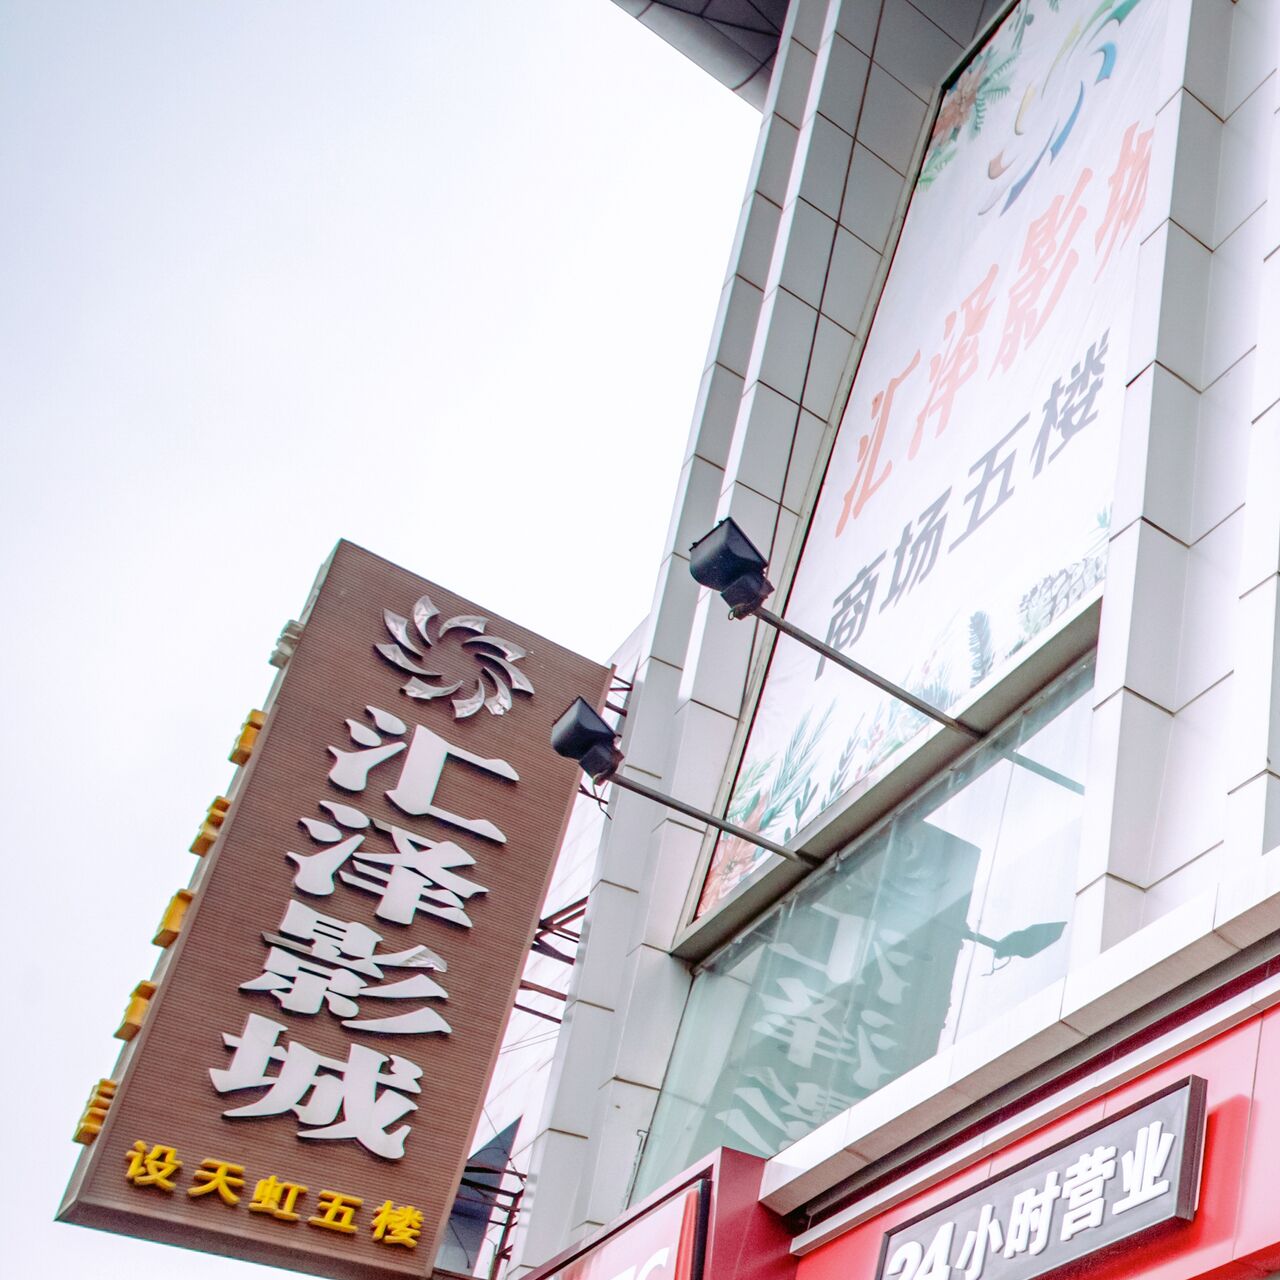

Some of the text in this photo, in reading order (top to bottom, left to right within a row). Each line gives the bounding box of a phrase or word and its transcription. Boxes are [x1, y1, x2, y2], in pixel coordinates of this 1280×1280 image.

[813, 327, 1112, 682] 商场五楼
[208, 704, 520, 1161] 汇泽影城
[125, 1140, 426, 1249] 设天虹五楼
